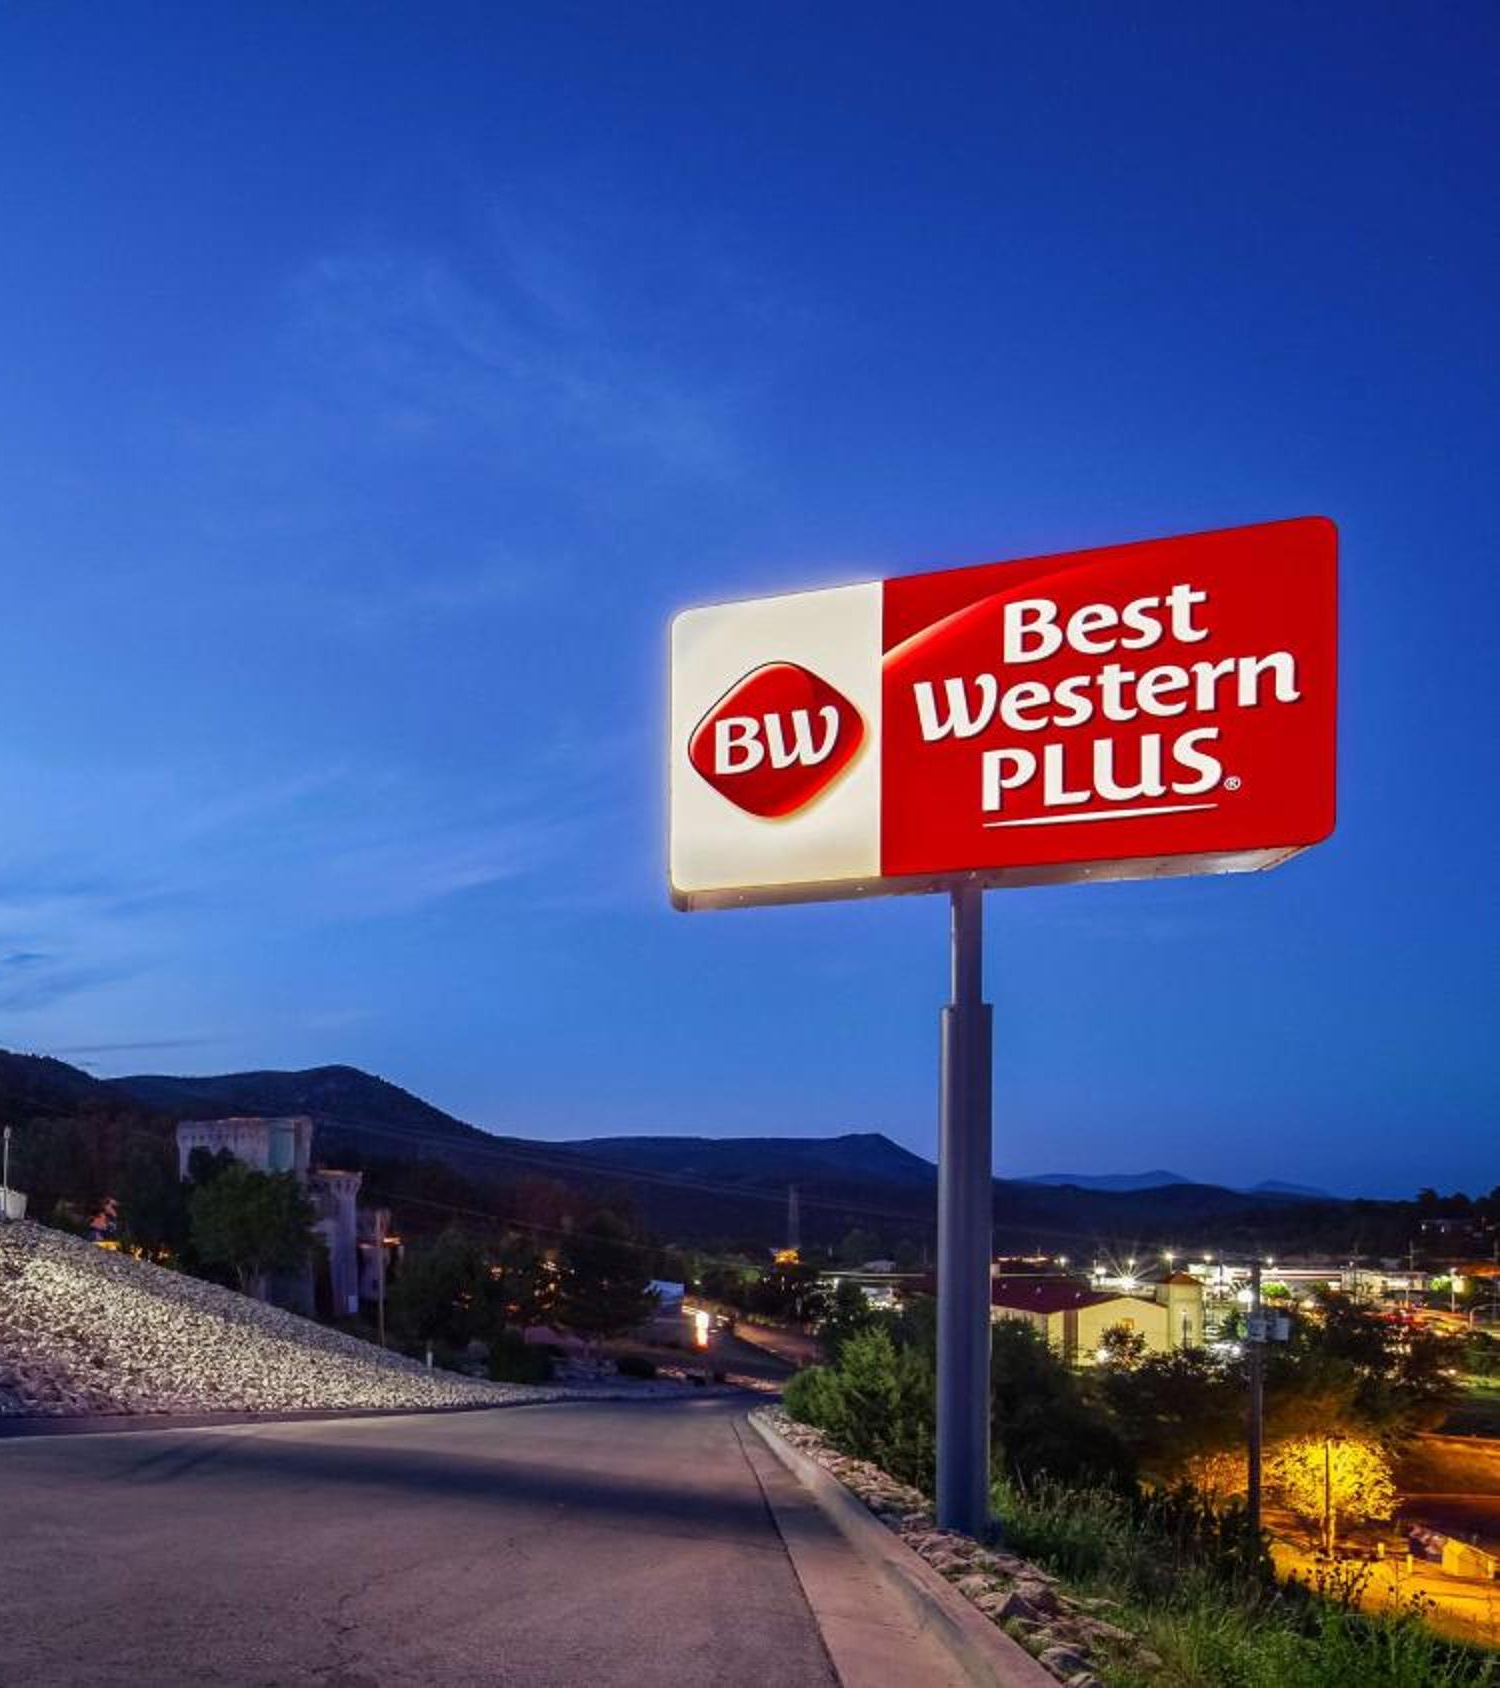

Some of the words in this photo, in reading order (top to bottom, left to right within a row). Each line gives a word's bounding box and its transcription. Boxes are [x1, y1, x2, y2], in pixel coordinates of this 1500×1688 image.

[1003, 584, 1209, 663] Best
[913, 651, 1301, 741] Western
[714, 705, 840, 775] BW
[982, 727, 1223, 811] PLUS
